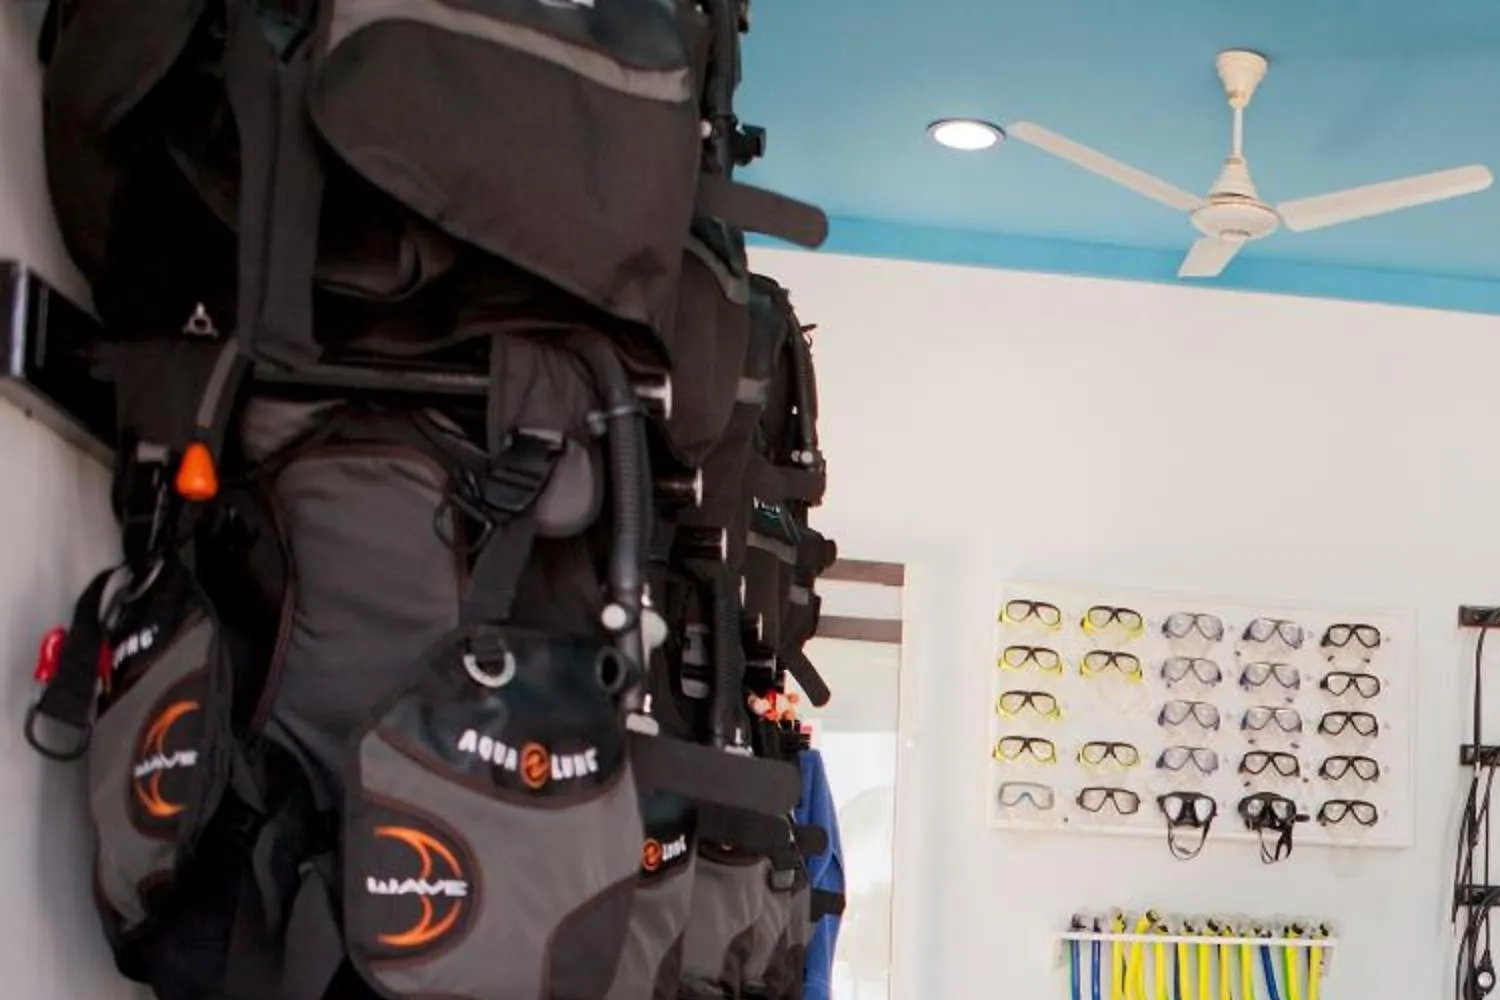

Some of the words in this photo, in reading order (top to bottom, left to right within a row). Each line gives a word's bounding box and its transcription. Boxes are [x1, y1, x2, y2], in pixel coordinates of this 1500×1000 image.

[134, 750, 198, 778] WAVE
[458, 729, 518, 772] AQUA
[551, 747, 599, 781] LUNG
[366, 876, 468, 897] WAVE
